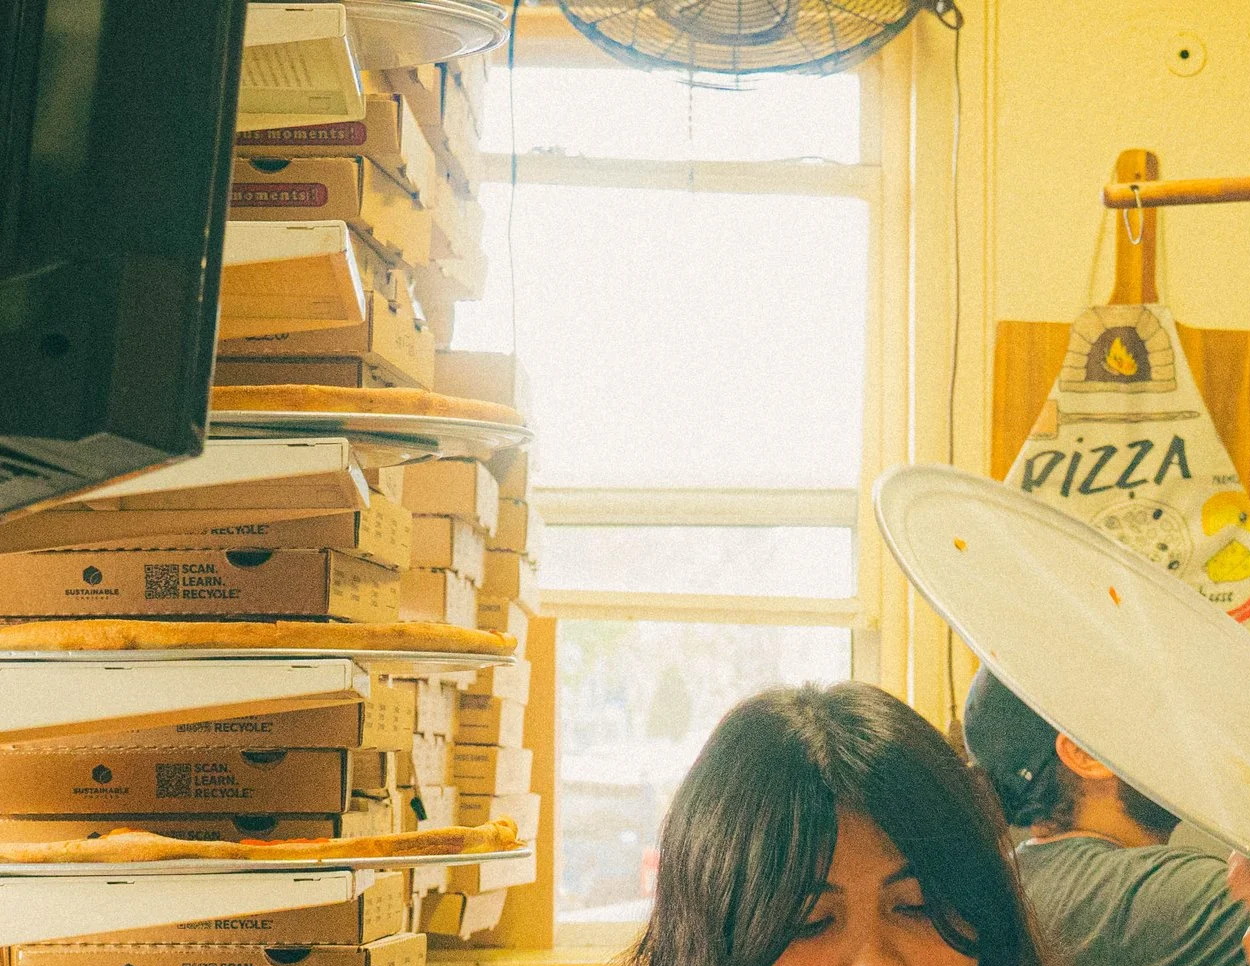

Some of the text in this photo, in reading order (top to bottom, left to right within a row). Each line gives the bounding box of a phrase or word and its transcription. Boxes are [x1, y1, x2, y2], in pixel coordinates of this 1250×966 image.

[182, 564, 218, 574] SCAN.
[182, 577, 225, 587] LEARN.
[194, 763, 231, 773] SCAN.
[194, 776, 239, 786] LEARN.
[73, 787, 129, 795] SUSTAINABLE
